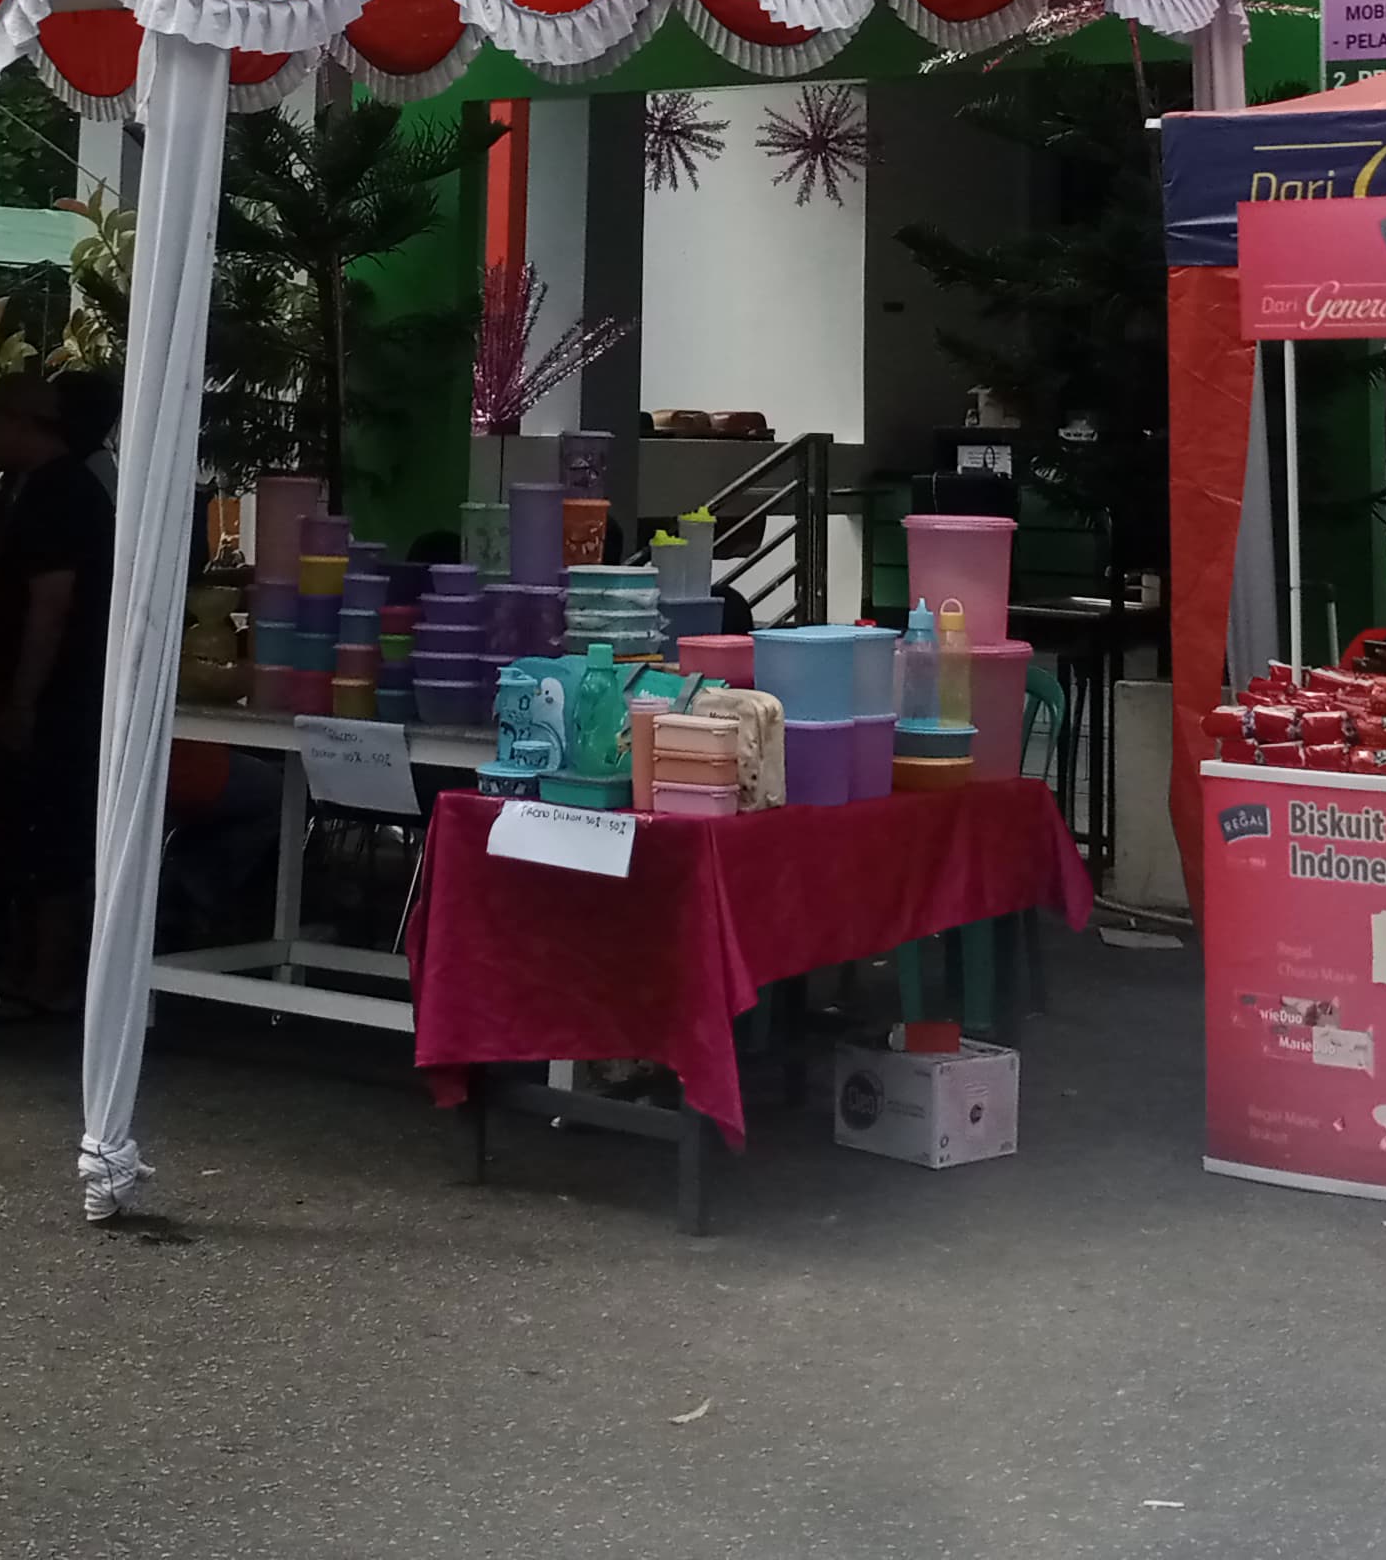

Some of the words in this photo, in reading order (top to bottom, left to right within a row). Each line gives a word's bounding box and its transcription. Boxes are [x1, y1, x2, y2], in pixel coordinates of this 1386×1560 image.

[1262, 295, 1298, 314] Dari
[1224, 815, 1264, 833] REGAL
[1289, 801, 1386, 842] Biskuit
